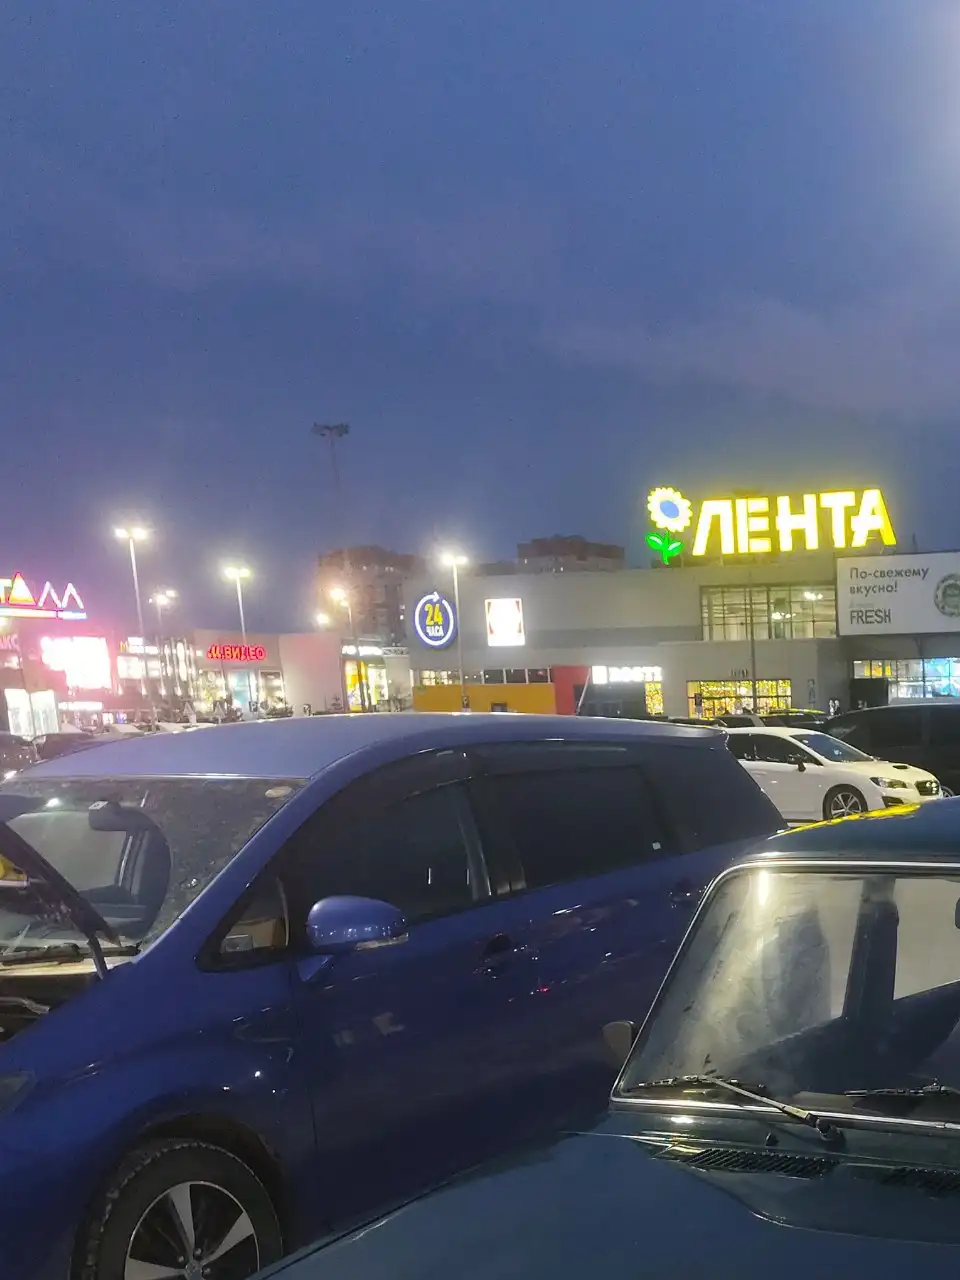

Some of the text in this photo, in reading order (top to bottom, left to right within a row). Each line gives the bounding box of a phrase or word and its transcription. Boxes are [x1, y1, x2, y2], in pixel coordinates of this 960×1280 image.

[692, 488, 897, 557] ЛЕНТА
[849, 566, 930, 581] По-свежему
[849, 580, 898, 597] вкусно!
[425, 603, 443, 626] 24
[849, 608, 892, 625] FRESH
